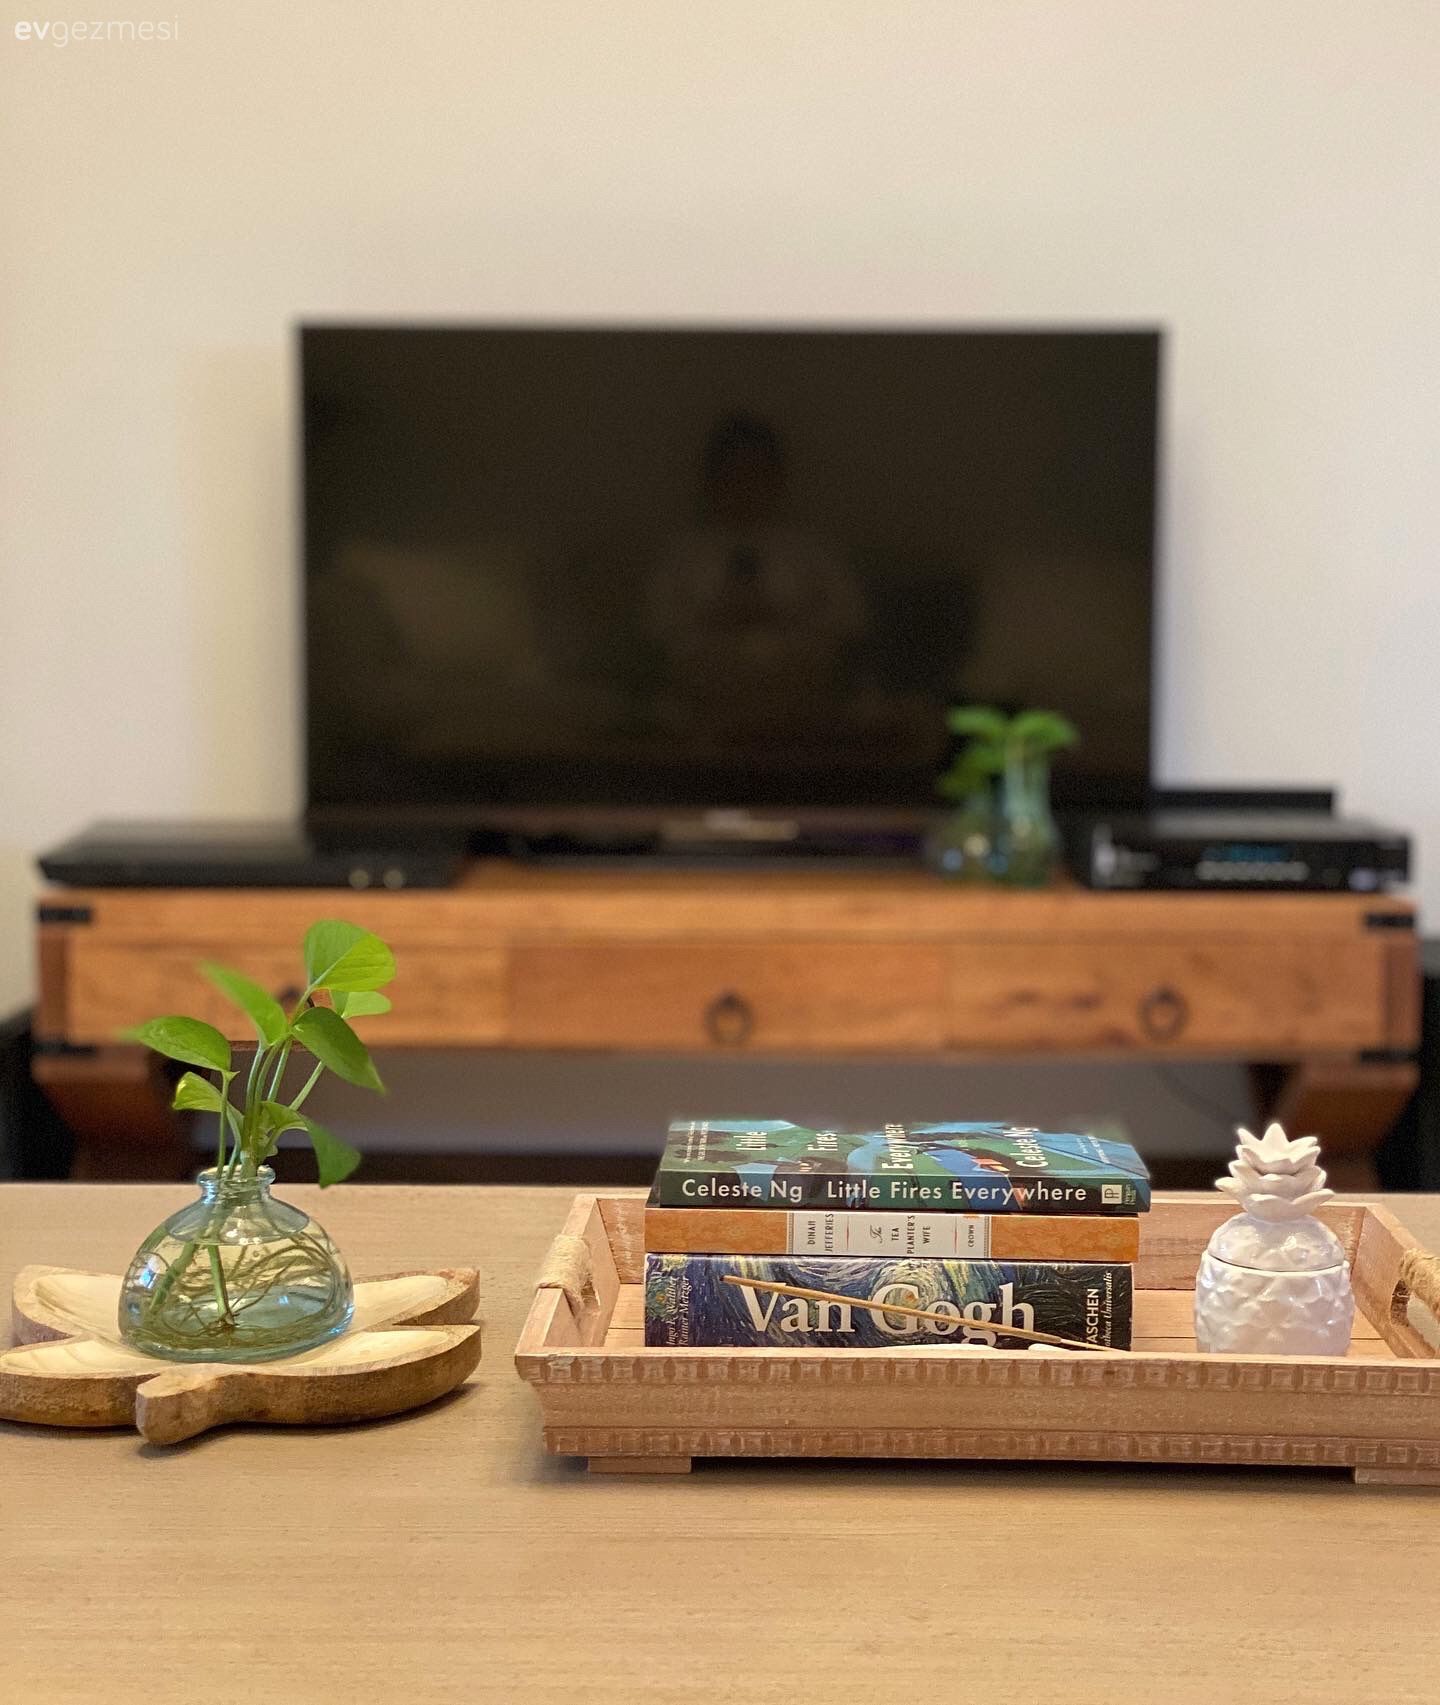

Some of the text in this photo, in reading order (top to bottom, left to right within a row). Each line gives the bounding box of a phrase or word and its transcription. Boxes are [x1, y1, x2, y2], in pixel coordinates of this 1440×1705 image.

[733, 1131, 768, 1151] Little
[806, 1133, 839, 1151] Fires
[1009, 1138, 1049, 1168] Celeste
[682, 1177, 1087, 1205] Celeste Ng Little Fires Everywhere
[807, 1220, 816, 1245] DINAH
[824, 1213, 834, 1252] JEFFERIES
[891, 1227, 900, 1241] TEA
[906, 1215, 915, 1254] PLANTER'S
[922, 1226, 931, 1244] WIFE
[680, 1275, 692, 1314] Metzger
[1101, 1271, 1113, 1319] Universalis
[740, 1282, 1035, 1347] Van Gogh
[1086, 1288, 1099, 1345] ASCHEN
